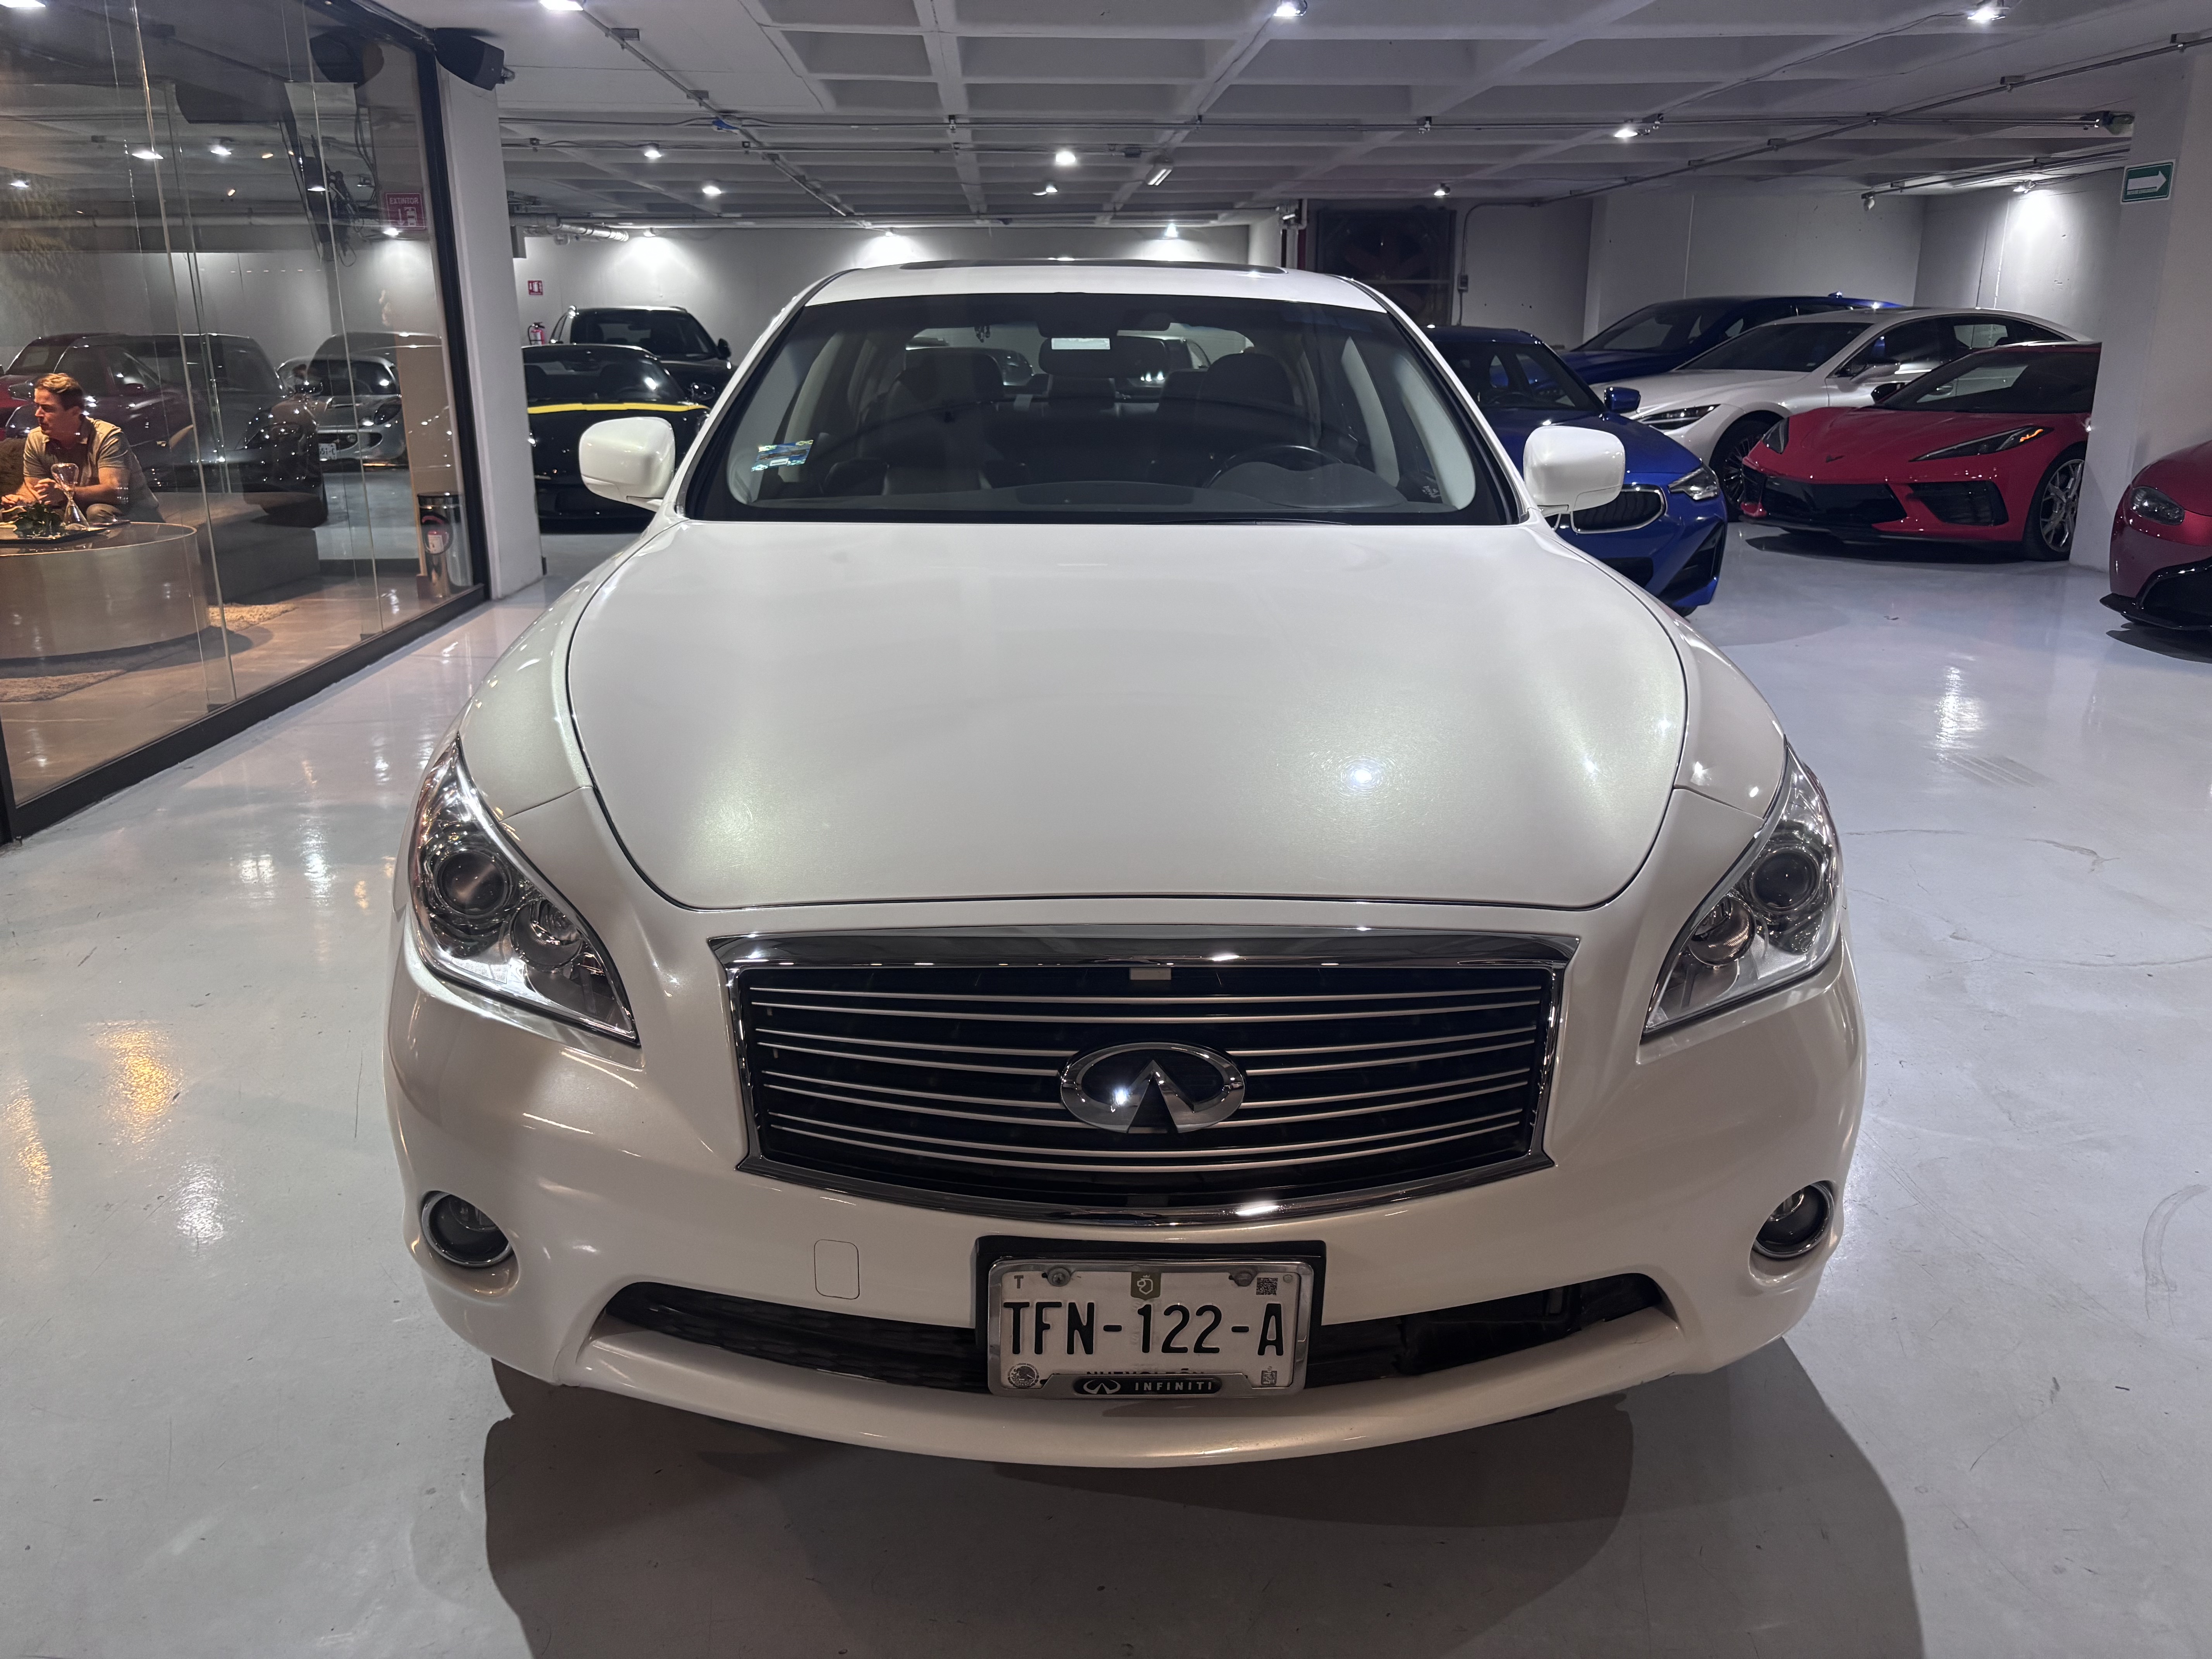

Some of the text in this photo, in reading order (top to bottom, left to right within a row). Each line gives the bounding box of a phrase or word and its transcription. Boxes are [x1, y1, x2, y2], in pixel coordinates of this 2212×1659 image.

[1014, 1275, 1024, 1289] T
[1003, 1302, 1284, 1356] TFN-122-A
[1135, 1381, 1212, 1391] INFINITI
